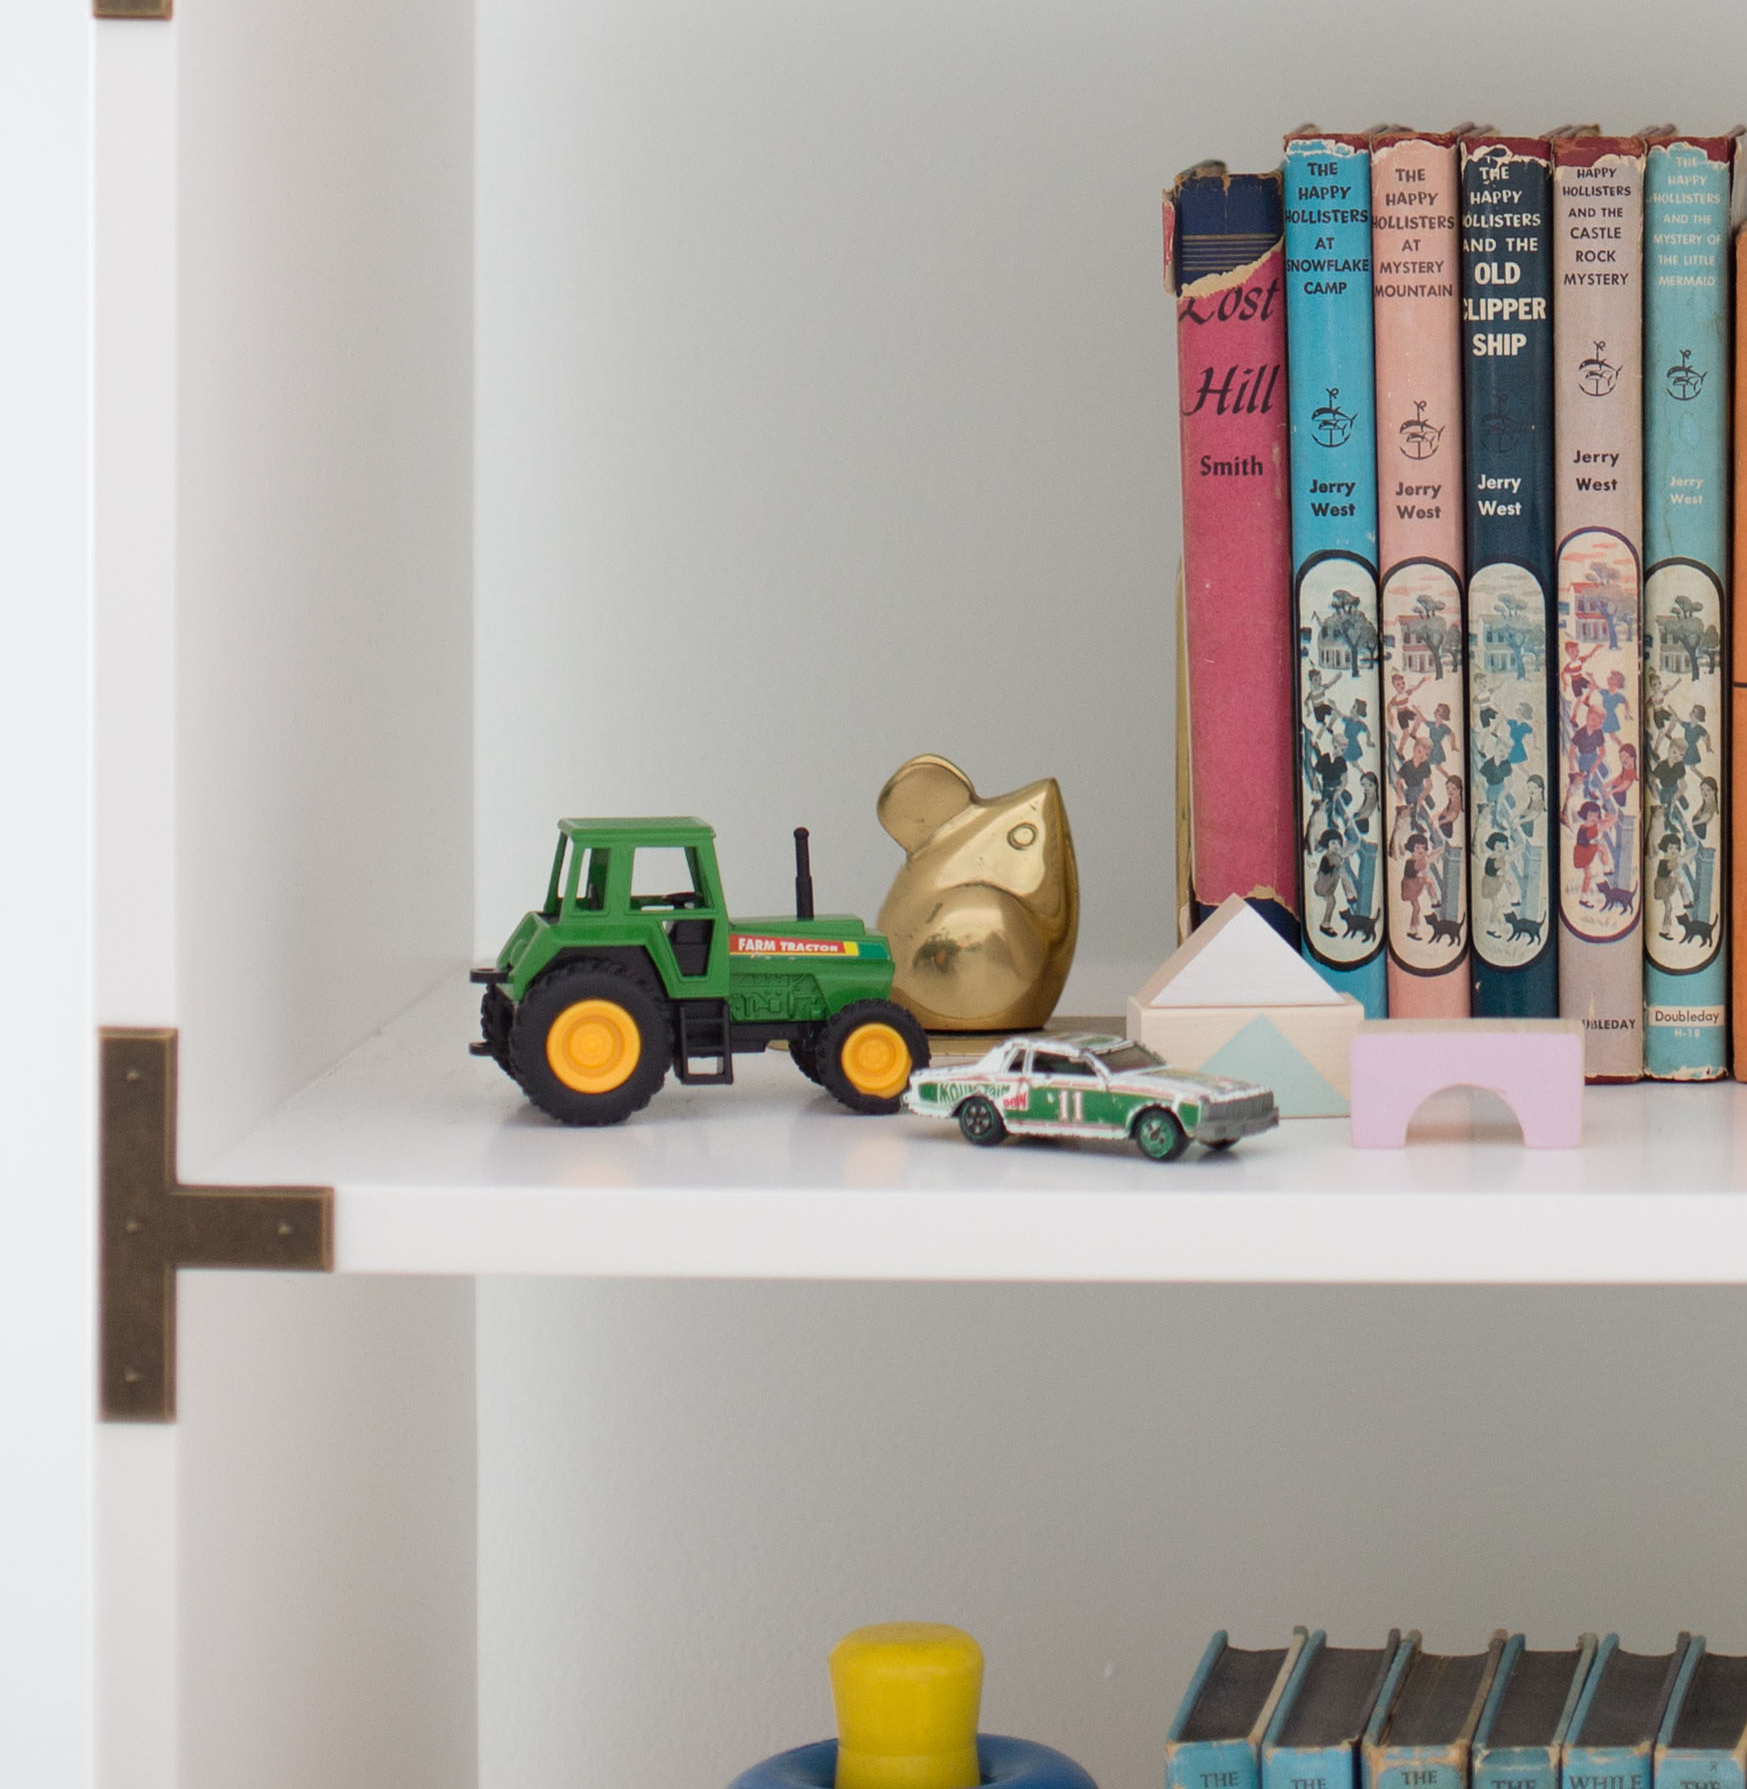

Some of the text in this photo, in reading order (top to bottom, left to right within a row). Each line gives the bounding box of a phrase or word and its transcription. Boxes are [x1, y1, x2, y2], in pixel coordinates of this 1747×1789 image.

[1307, 162, 1338, 177] THE
[1675, 157, 1698, 167] THE
[1395, 168, 1426, 183] THE
[1479, 166, 1510, 180] THE
[1577, 167, 1617, 179] HAPPY
[1667, 175, 1707, 186] HAPPY
[1298, 185, 1351, 201] HAPPY
[1386, 191, 1438, 206] HAPPY
[1470, 190, 1522, 205] HAPPY
[1562, 186, 1631, 197] HOLLISTERS
[1653, 193, 1721, 205] HOLLISTERS
[1285, 208, 1369, 224] HOLLISTERS
[1463, 213, 1541, 228] OLLISTERS
[1568, 208, 1623, 218] AND THE
[1664, 214, 1712, 225] AND THE
[1372, 215, 1455, 230] HOLLISTERS
[1570, 227, 1622, 239] CASTLE
[1653, 234, 1721, 245] MYSTERY OF
[1315, 237, 1335, 250] AT
[1402, 239, 1421, 252] AT
[1463, 237, 1538, 252] AND THE
[1575, 250, 1616, 262] ROCK
[1658, 254, 1715, 266] THE LITTLE
[1286, 258, 1369, 273] SNOWFLAKE
[1380, 260, 1444, 274] MYSTERY
[1474, 262, 1521, 285] OLD
[1563, 273, 1628, 285] MYSTERY
[1658, 275, 1715, 287] MERMAID
[1303, 281, 1347, 295] CAMP
[1375, 284, 1453, 298] MOUNTAIN
[1472, 333, 1527, 356] SHIP
[1182, 364, 1280, 417] Hill
[1200, 455, 1263, 477] Smith
[1573, 450, 1620, 470] Jerry
[1309, 479, 1356, 499] Jerry
[1478, 475, 1521, 495] Jerry
[1576, 477, 1618, 493] West
[1670, 476, 1703, 491] Jerry
[1395, 482, 1442, 502] Jerry
[1670, 492, 1703, 505] West
[1311, 502, 1356, 517] West
[1397, 505, 1442, 520] West
[1478, 499, 1521, 516] West
[738, 936, 839, 953] FARM TRACTOR
[1655, 1010, 1720, 1023] Doubleday
[1582, 1019, 1636, 1030] UBLEDAY
[1058, 1090, 1084, 1122] 11
[1201, 1772, 1239, 1788] THE
[1402, 1770, 1438, 1786] THE
[1568, 1775, 1643, 1789] WHILE
